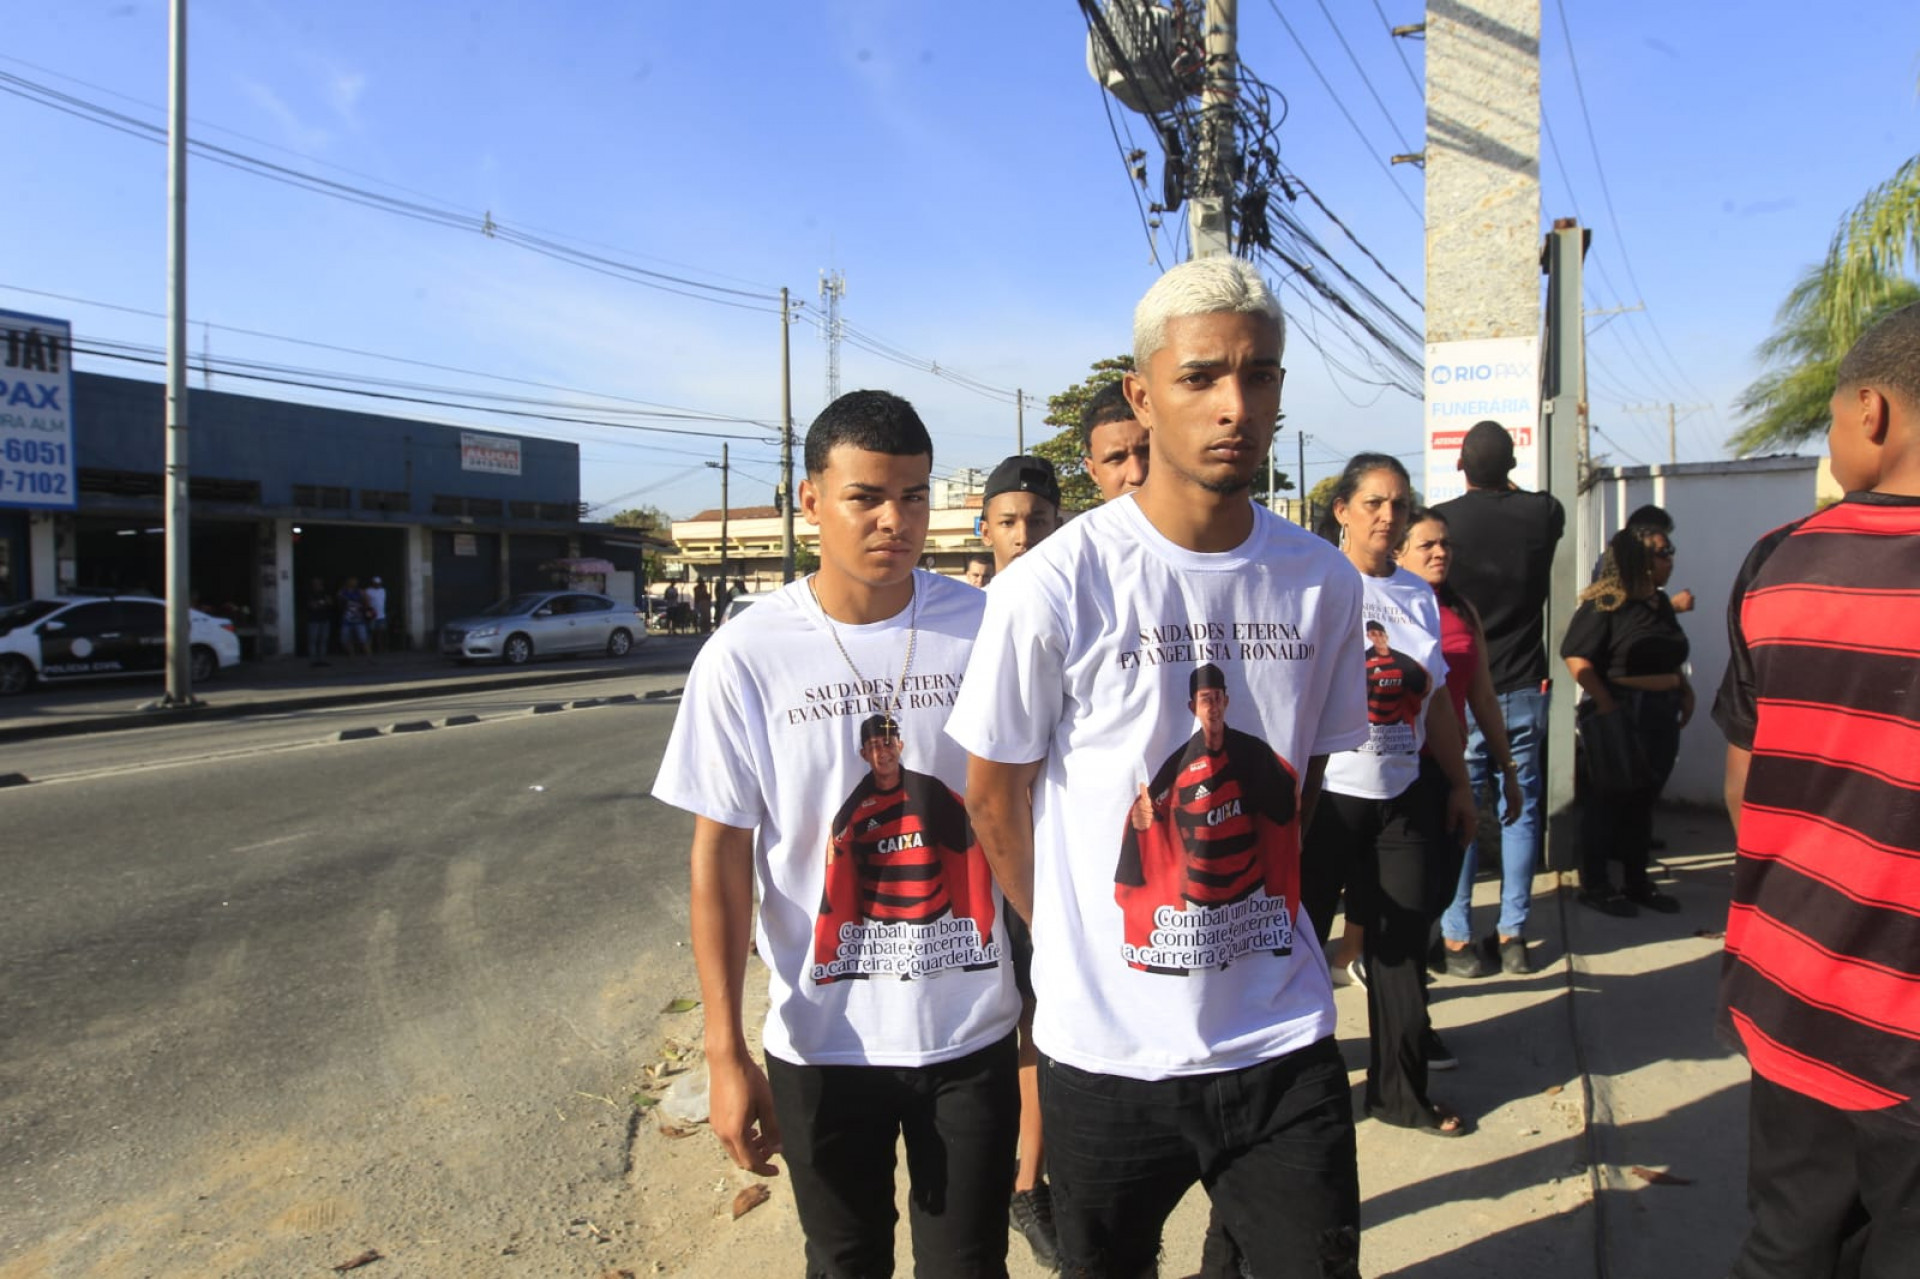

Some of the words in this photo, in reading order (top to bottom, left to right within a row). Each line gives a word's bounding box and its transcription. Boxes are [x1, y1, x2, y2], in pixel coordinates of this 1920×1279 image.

[1455, 365, 1492, 382] RIO
[1495, 362, 1533, 380] PAX
[1432, 395, 1531, 417] FUNERÁRIA
[1139, 622, 1225, 646] SAUDADES
[1232, 622, 1302, 641] ETERNA
[1120, 642, 1232, 670] EVANGELISTA
[1240, 642, 1315, 661] RONALDO
[804, 678, 894, 703] SAUDADES
[787, 694, 903, 726] EVANGELISTA
[1206, 799, 1243, 828] CAIXA
[877, 832, 924, 854] CAIXA
[1157, 907, 1229, 928] Combati
[1231, 905, 1247, 919] um
[1249, 897, 1284, 914] bom
[1233, 911, 1289, 937] encerrei
[841, 921, 907, 940] Combati
[911, 924, 936, 939] um
[940, 917, 974, 933] bom
[914, 934, 979, 953] encerrei
[1124, 946, 1134, 960] a
[1140, 945, 1215, 966] carreira
[814, 964, 824, 978] a
[828, 957, 893, 974] carreira
